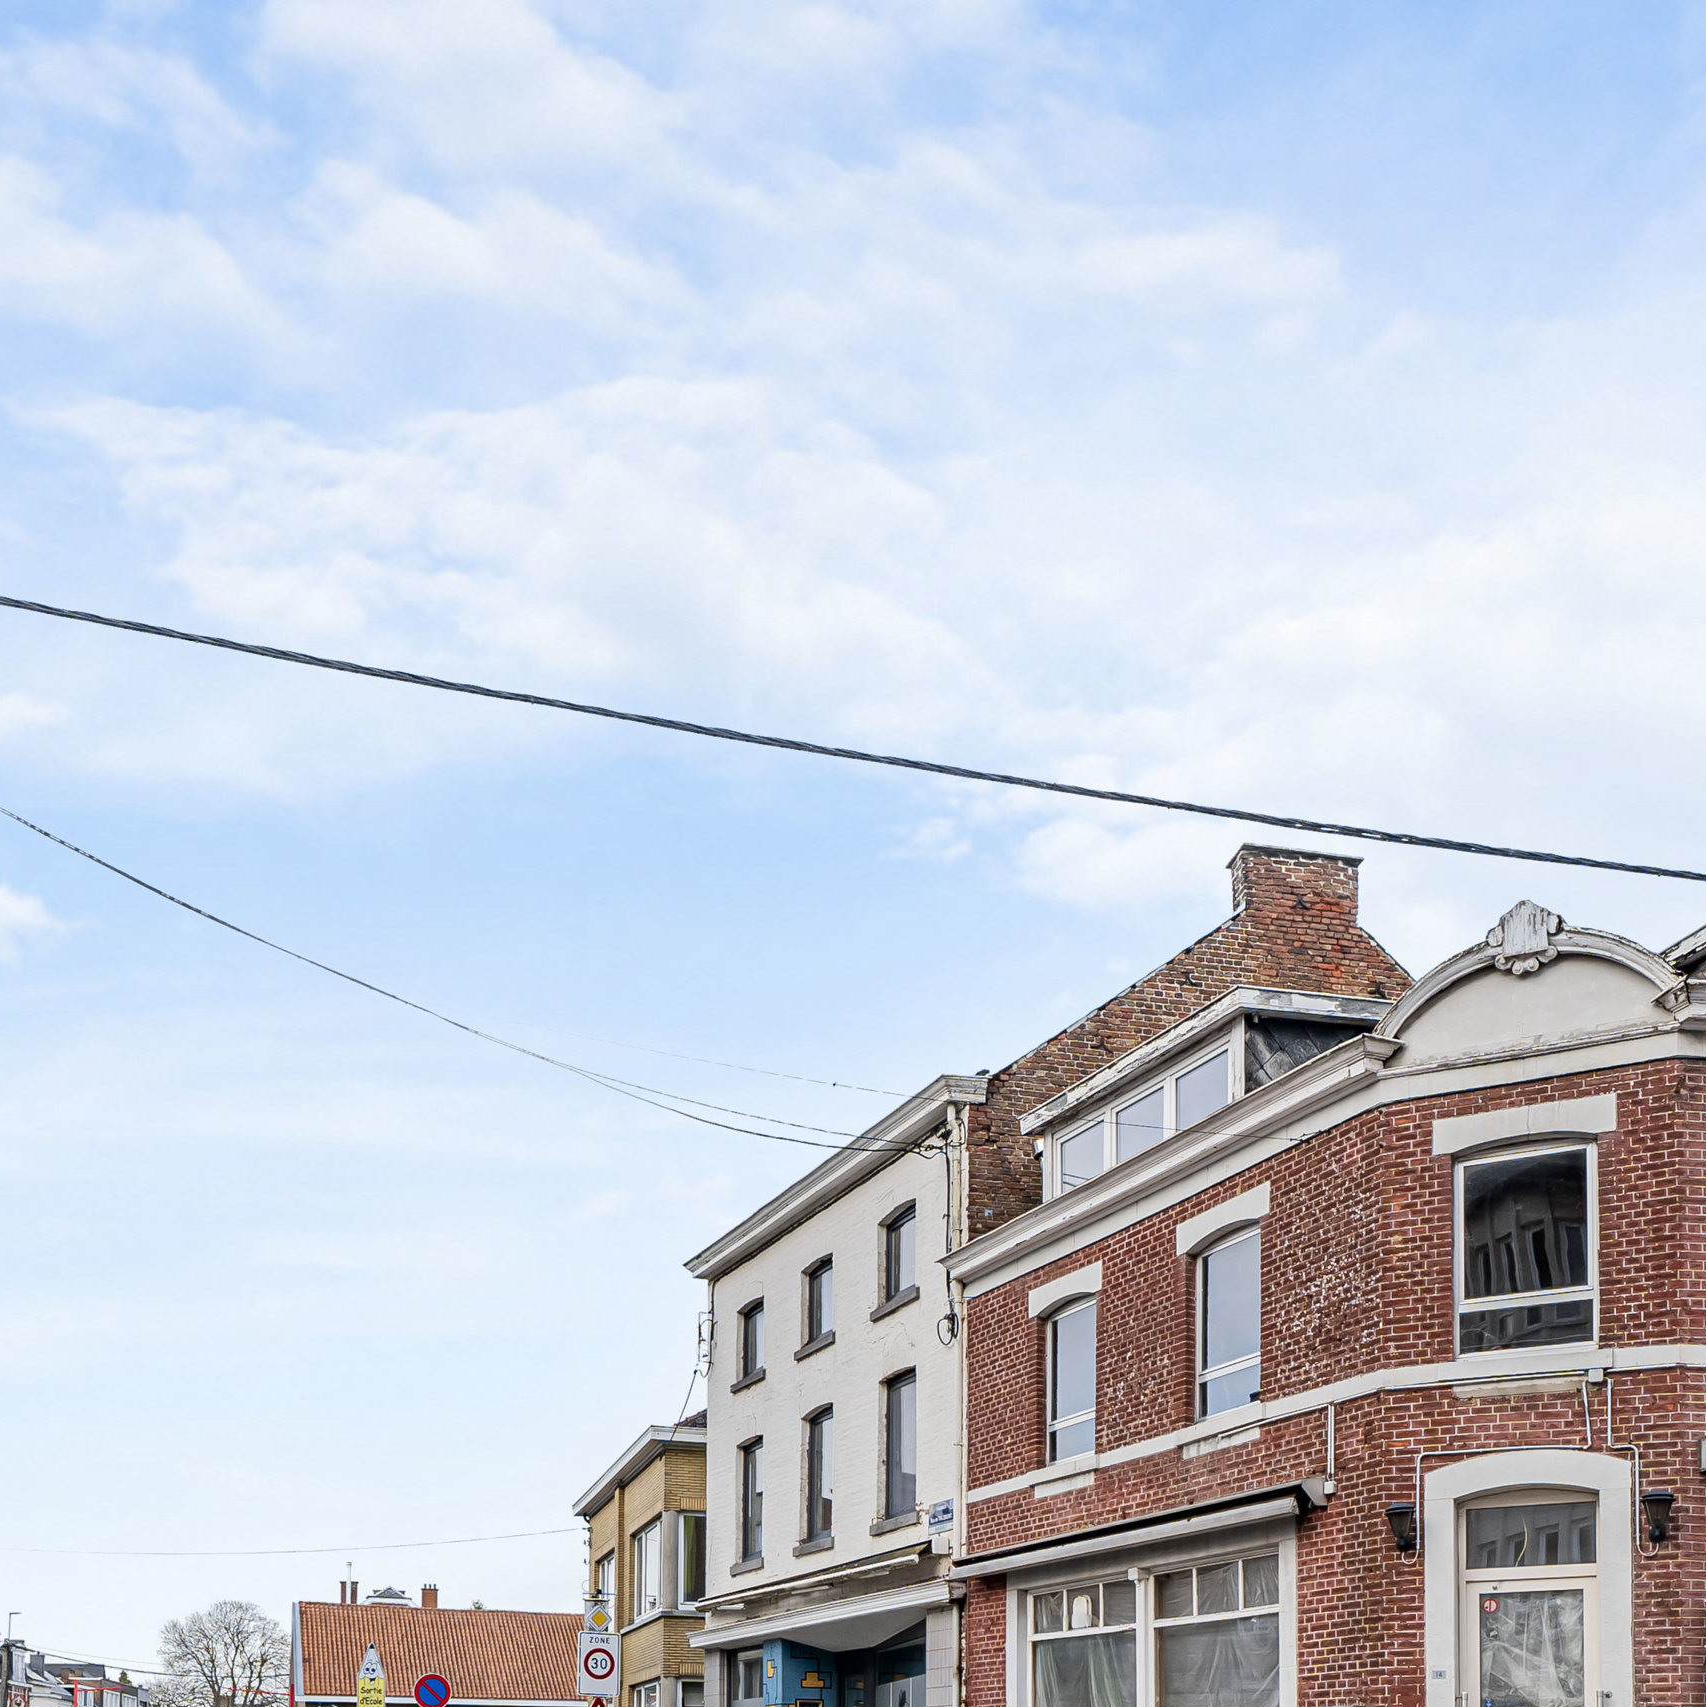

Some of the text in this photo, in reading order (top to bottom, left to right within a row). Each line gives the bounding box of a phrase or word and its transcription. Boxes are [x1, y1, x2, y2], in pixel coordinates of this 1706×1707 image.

[589, 1636, 611, 1645] ZONE
[591, 1657, 608, 1670] 30
[360, 1686, 382, 1695] Sortie
